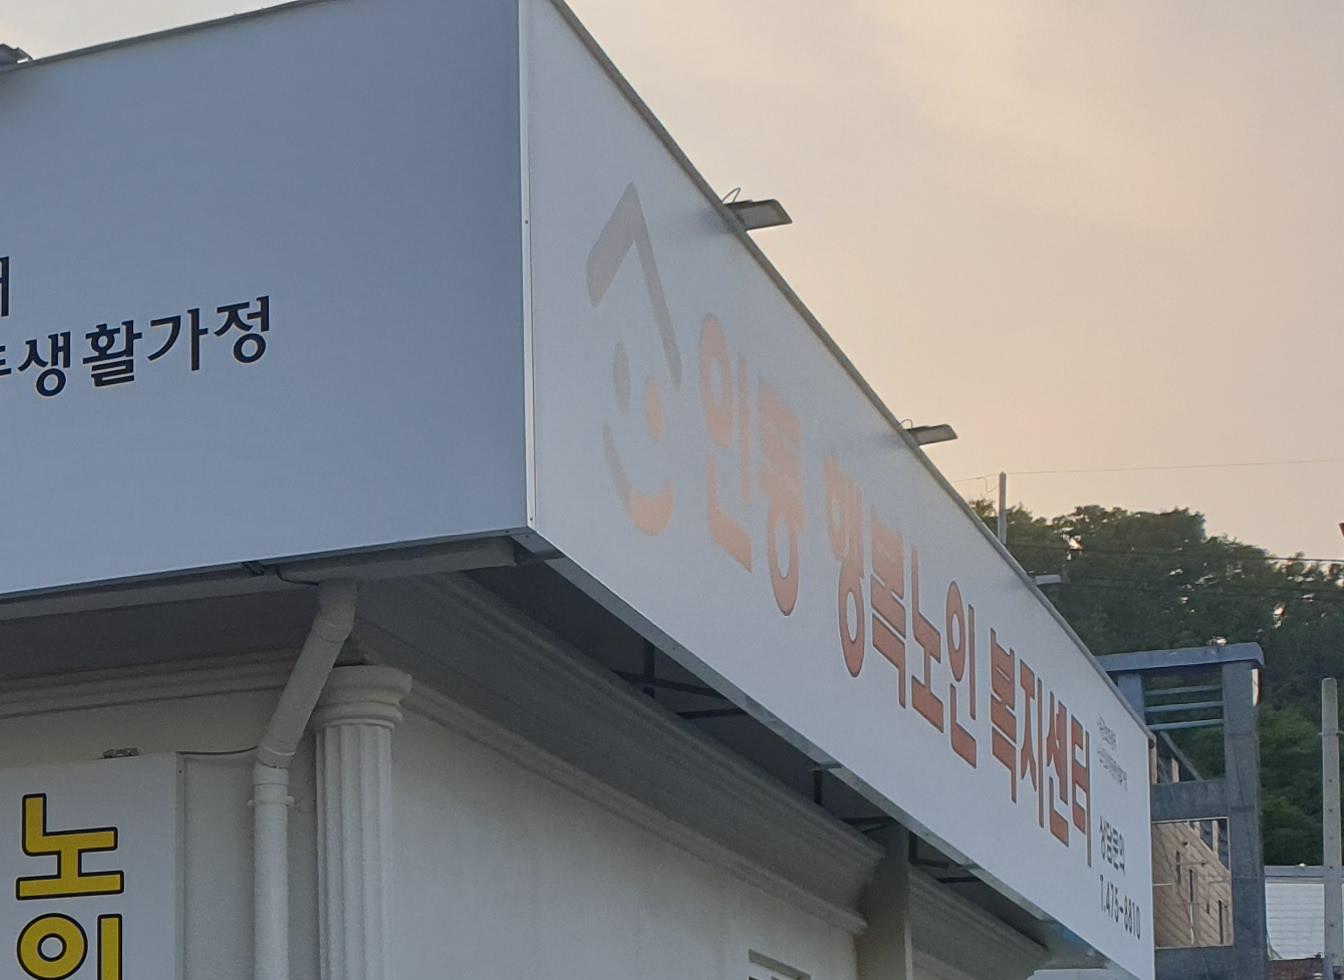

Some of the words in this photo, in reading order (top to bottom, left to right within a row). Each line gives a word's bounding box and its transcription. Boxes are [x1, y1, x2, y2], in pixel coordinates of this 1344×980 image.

[699, 313, 805, 616] 인동
[1099, 815, 1126, 875] 상담문의
[1099, 874, 1141, 940] T.475-8810
